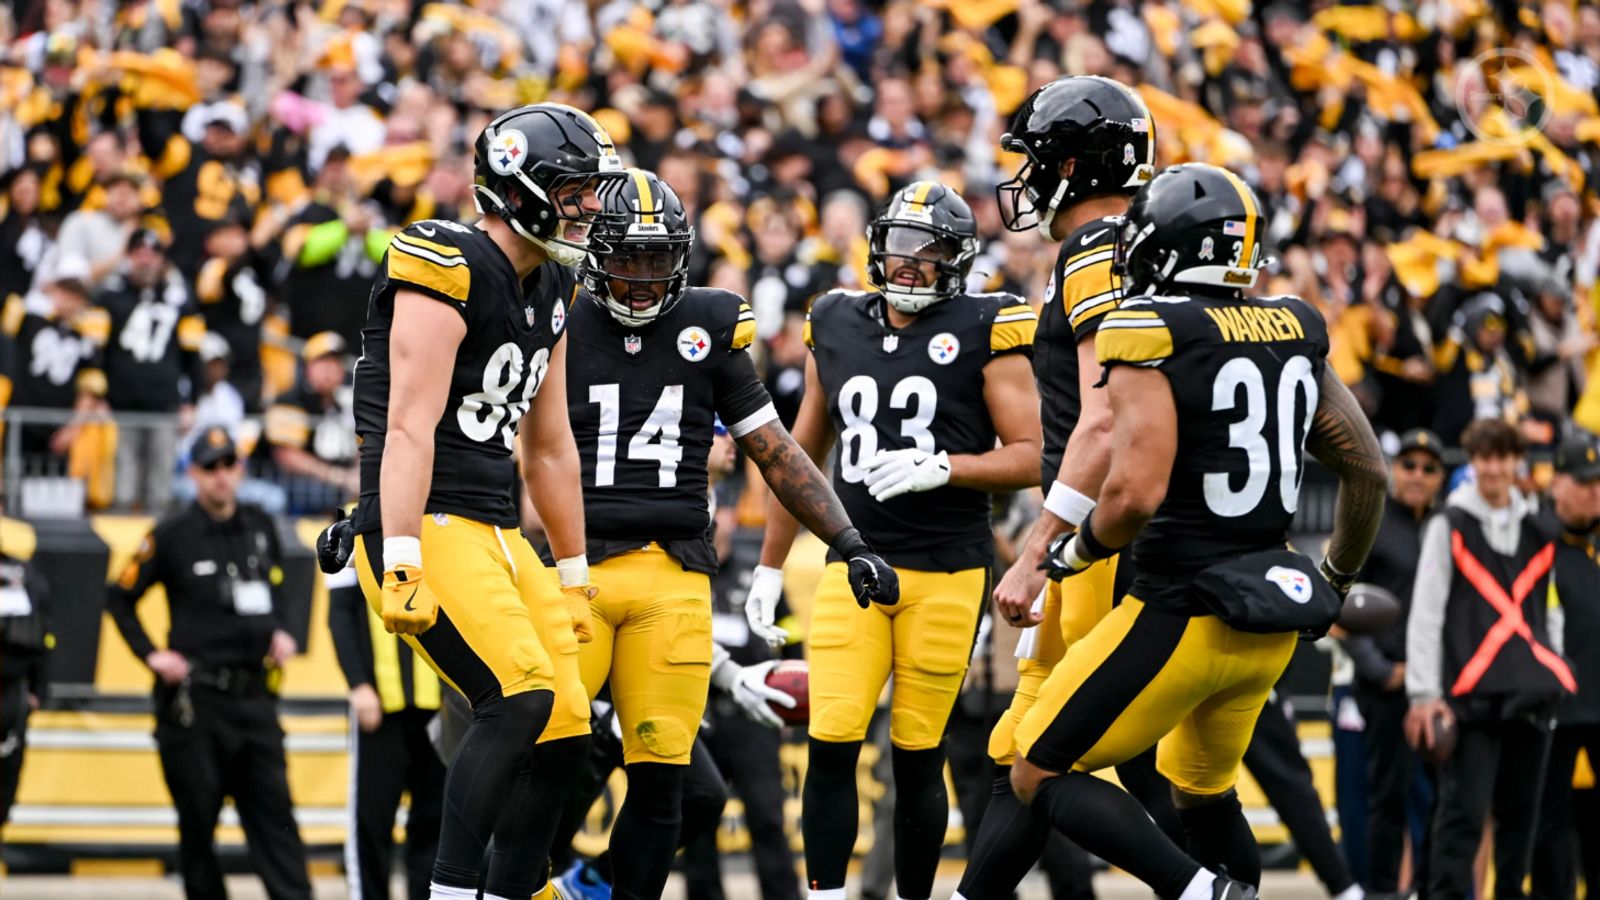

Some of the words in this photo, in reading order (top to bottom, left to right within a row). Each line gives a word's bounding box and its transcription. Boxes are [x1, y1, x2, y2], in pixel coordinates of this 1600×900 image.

[632, 199, 664, 223] 14
[1228, 241, 1260, 269] 30
[118, 302, 180, 363] 47
[1204, 306, 1305, 342] WARREN
[457, 342, 549, 450] 88
[588, 383, 684, 488] 14
[838, 375, 938, 483] 83
[1203, 355, 1319, 517] 30
